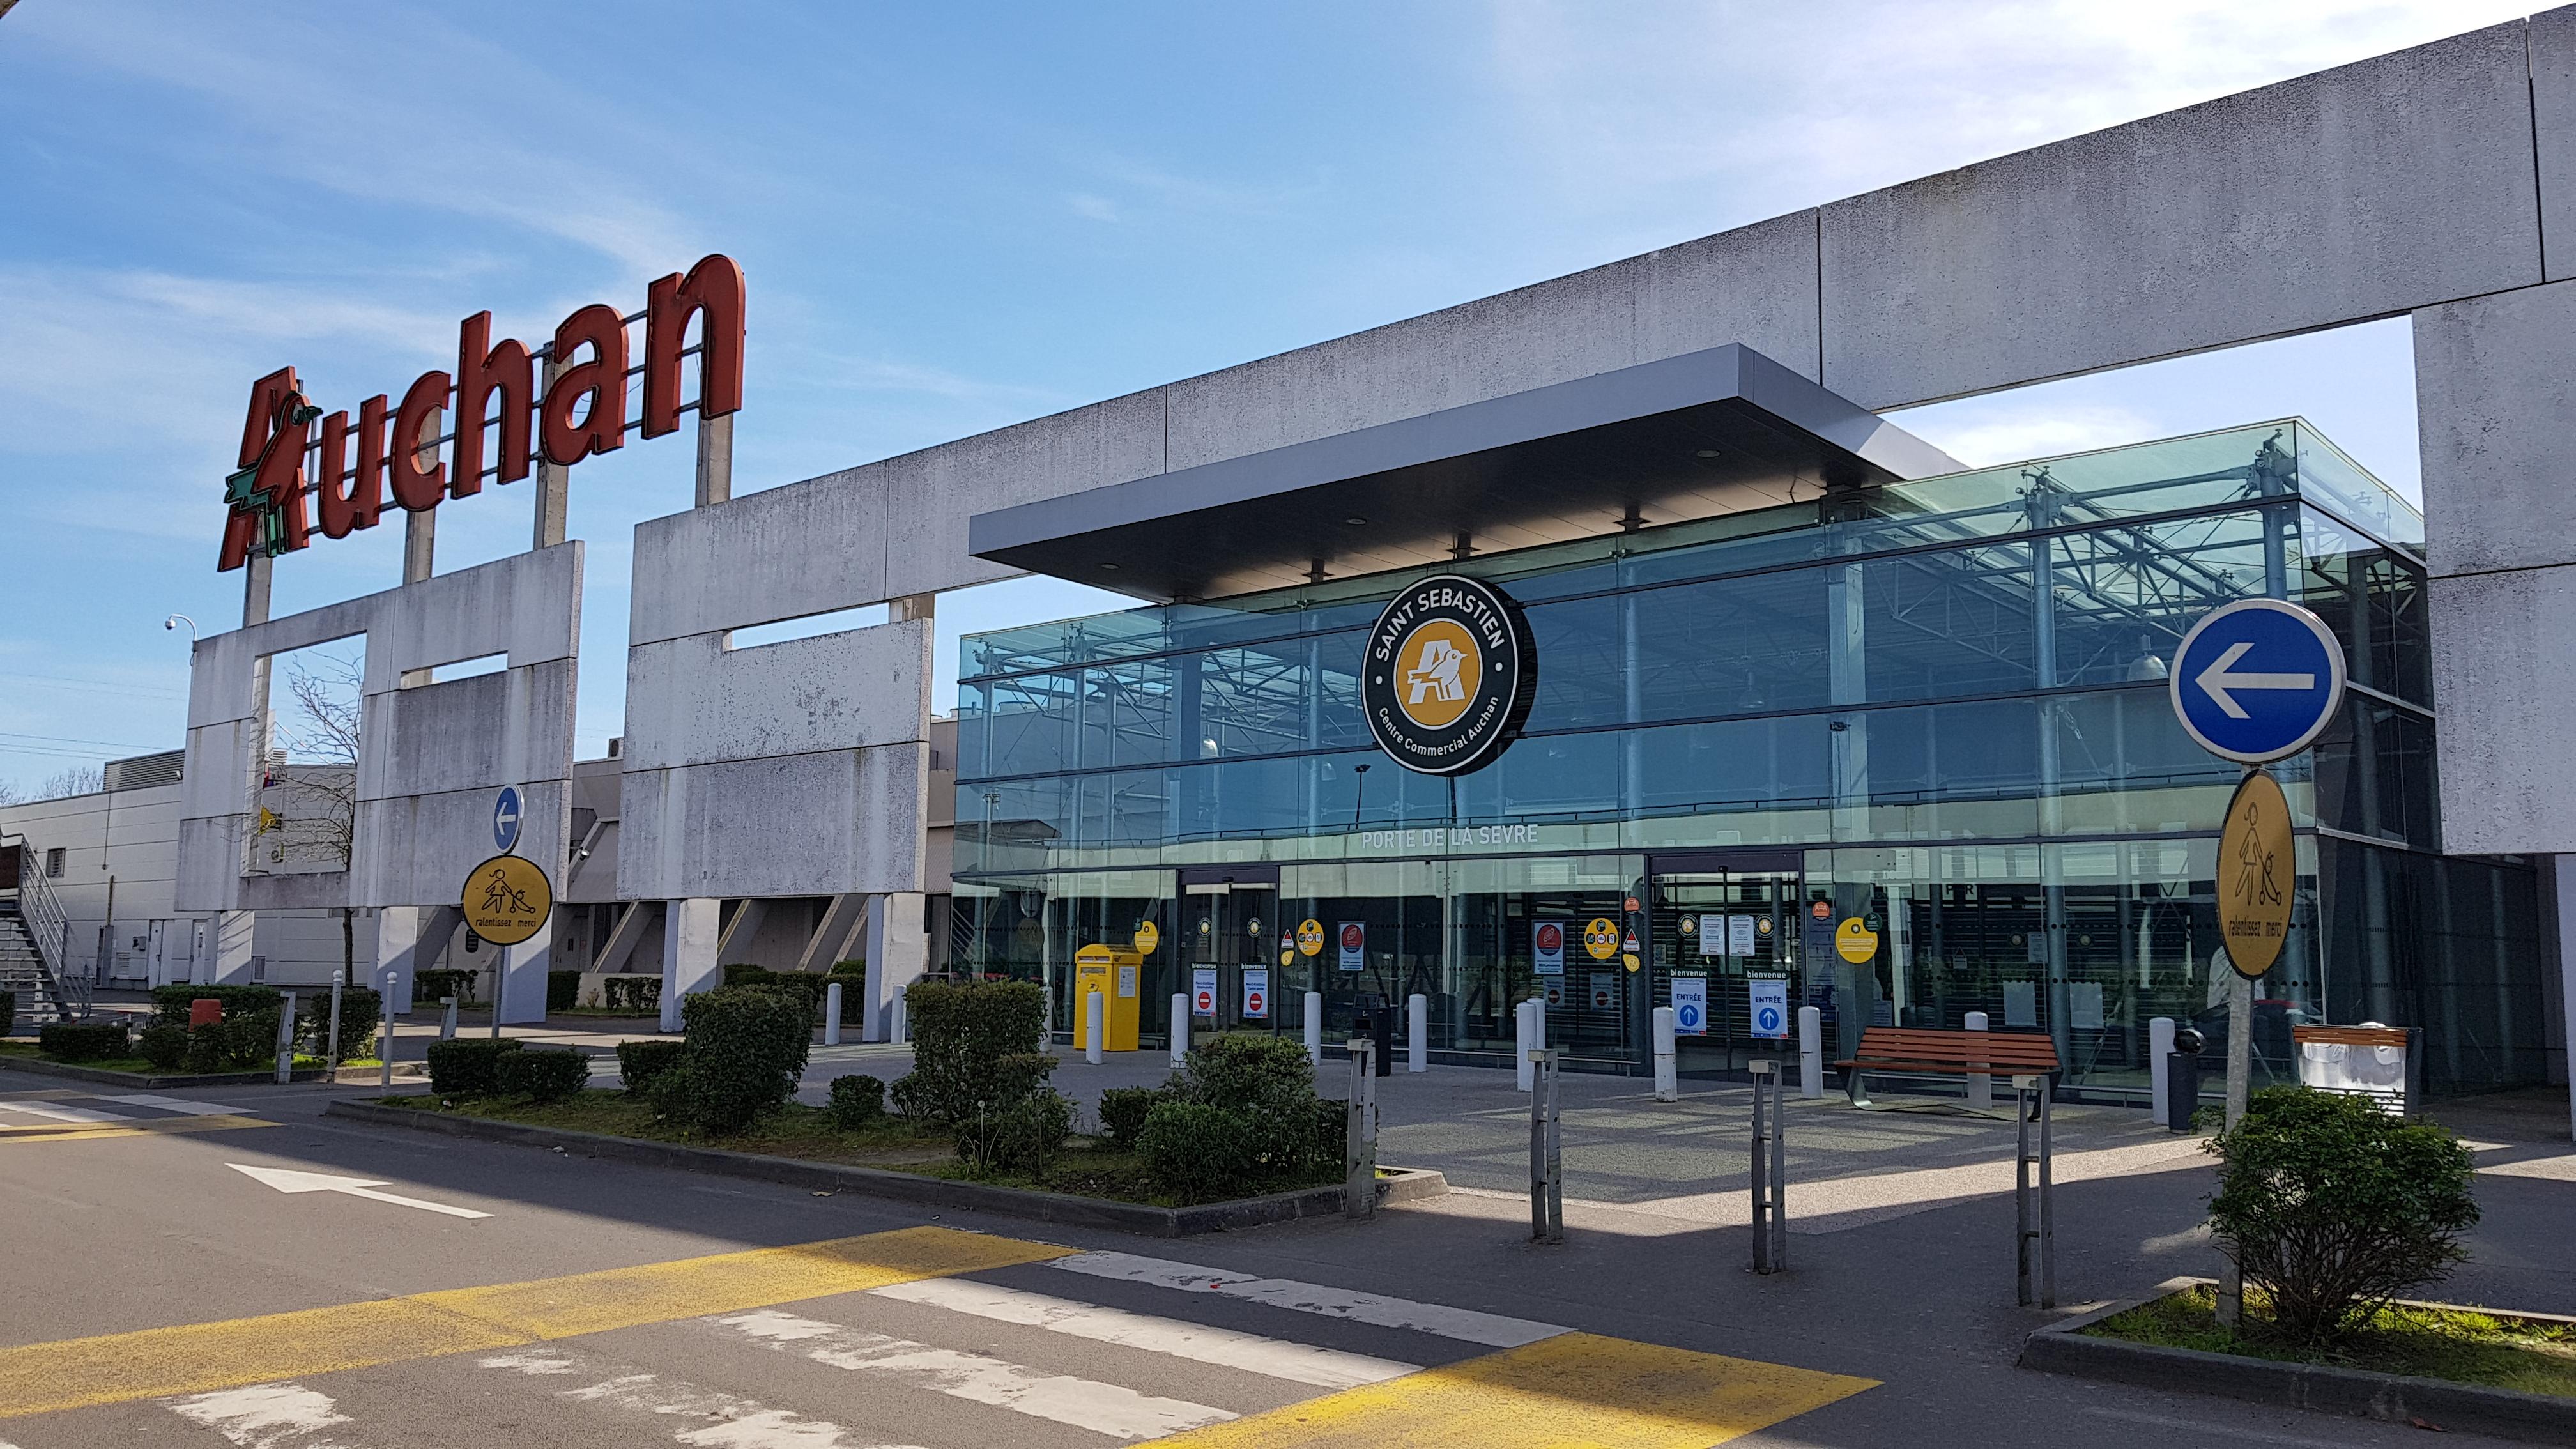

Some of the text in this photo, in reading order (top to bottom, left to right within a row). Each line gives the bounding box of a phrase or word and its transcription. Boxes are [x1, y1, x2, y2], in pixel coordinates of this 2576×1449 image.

[217, 254, 746, 572] Auchan
[1376, 588, 1505, 662] SAINT SEBASTIEN
[1379, 696, 1499, 757] Centre Commercial Auchan
[1361, 824, 1539, 850] PORTE DE LA SEVRE
[475, 917, 537, 927] ralentissez merci
[2228, 914, 2282, 937] ralentissez merci
[1670, 968, 1708, 977] bienvenue
[1747, 970, 1786, 979] bienvenue
[1676, 993, 1702, 1002] ENTRÉE
[1754, 995, 1782, 1004] ENTRÉE
